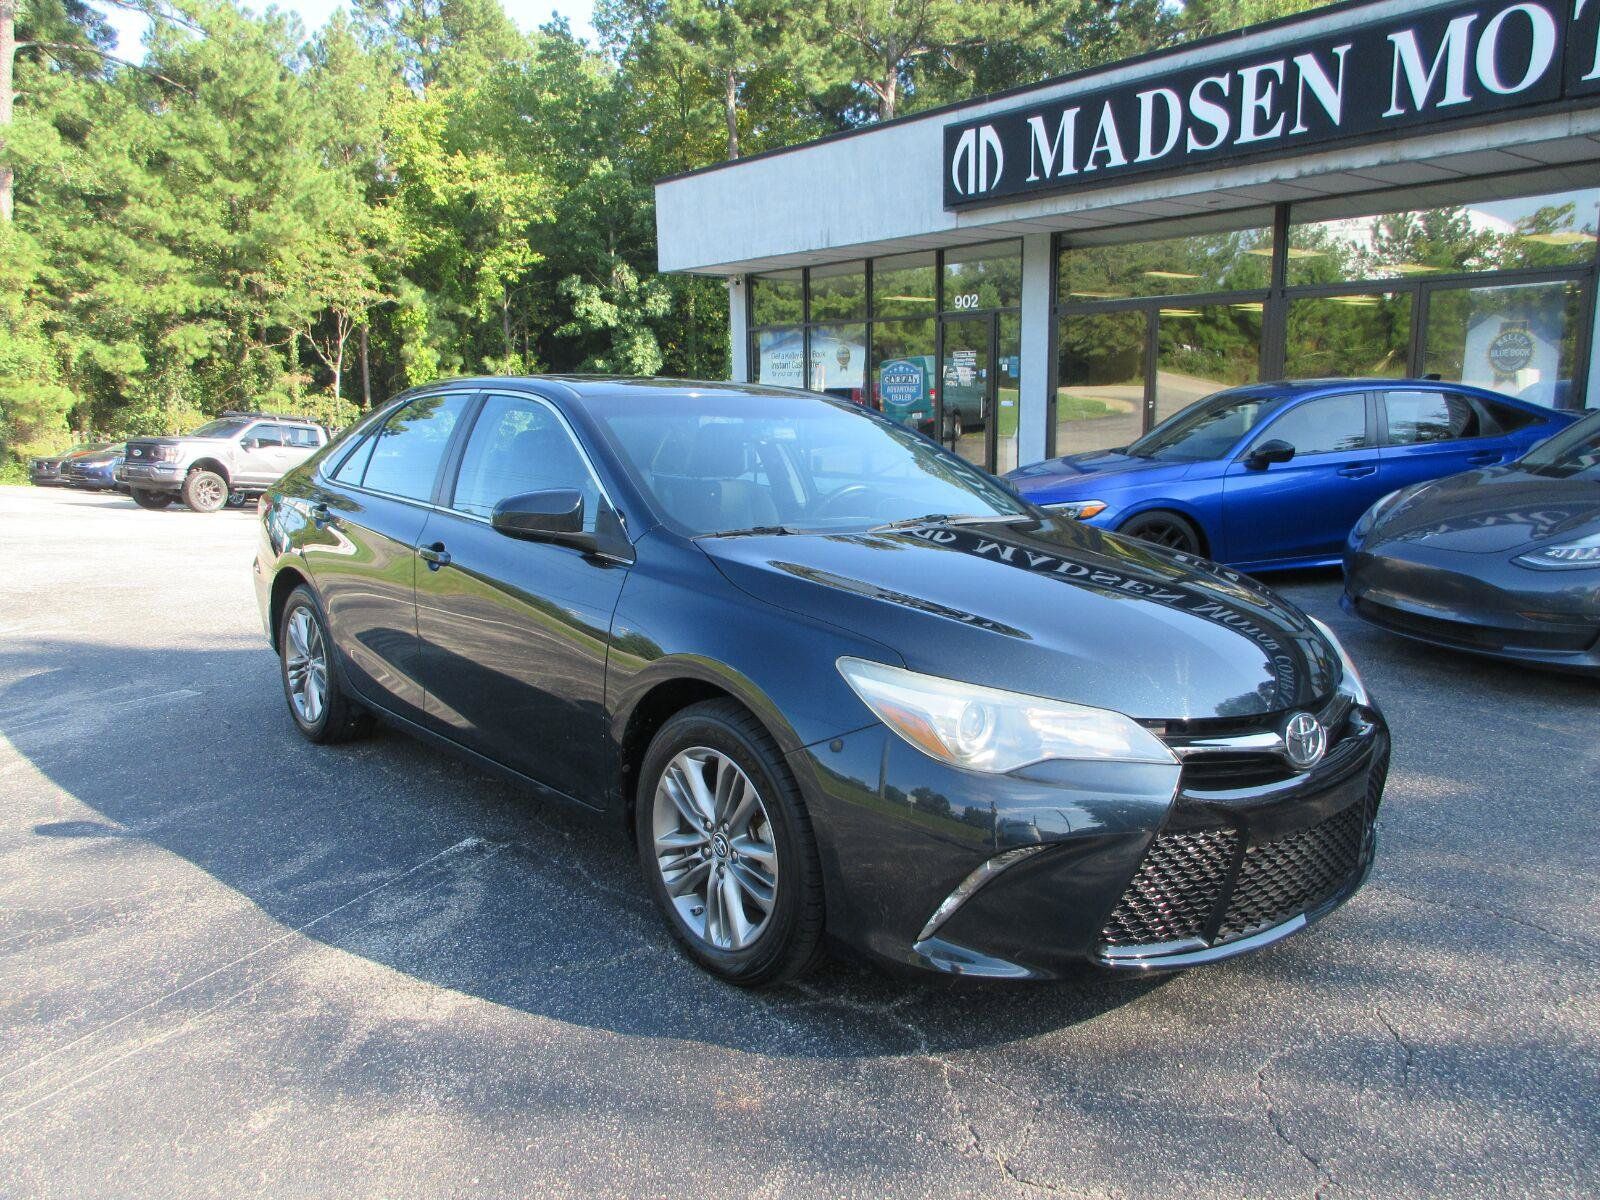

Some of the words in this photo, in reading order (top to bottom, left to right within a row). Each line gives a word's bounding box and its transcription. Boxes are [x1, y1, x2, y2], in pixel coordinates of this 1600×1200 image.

[1025, 44, 1352, 182] MADSEN
[954, 294, 979, 309] 902
[884, 374, 920, 384] CARFAX
[891, 393, 912, 401] DEALER
